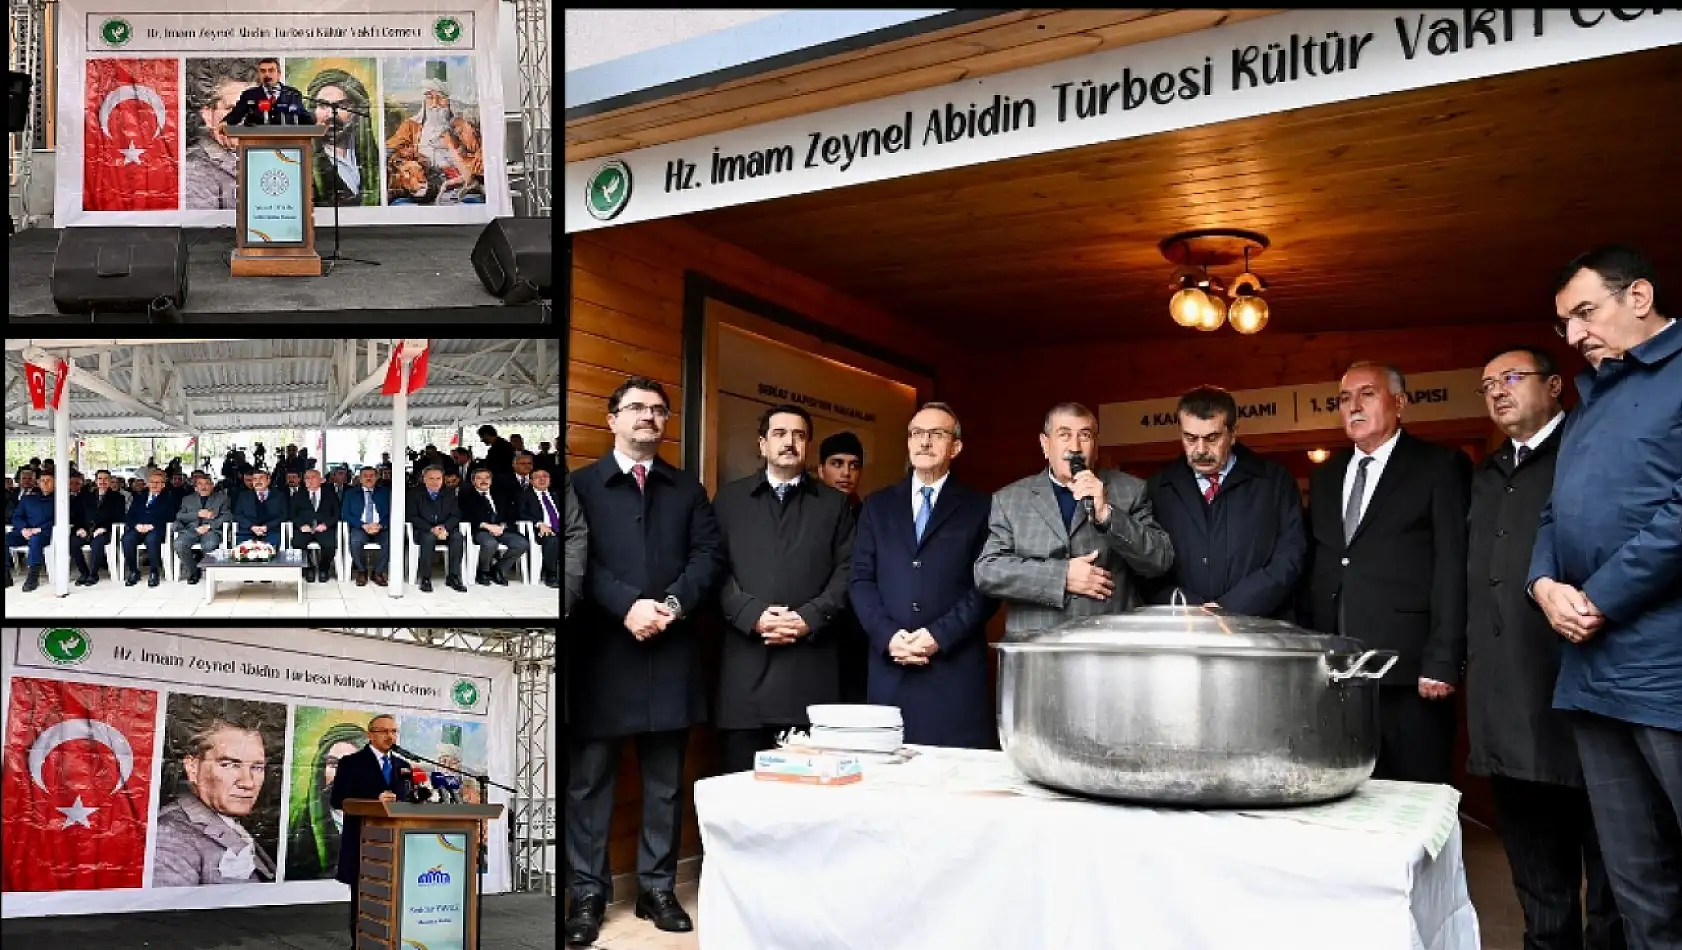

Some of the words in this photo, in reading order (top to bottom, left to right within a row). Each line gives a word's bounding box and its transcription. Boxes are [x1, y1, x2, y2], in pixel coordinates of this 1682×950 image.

[664, 160, 702, 193] Hz.
[710, 146, 793, 184] İmam
[804, 112, 912, 173] Zeynel
[923, 95, 1036, 146] Abidin
[1052, 57, 1212, 122] Türbesi
[1231, 30, 1374, 91] Kültür
[1140, 415, 1150, 427] 4
